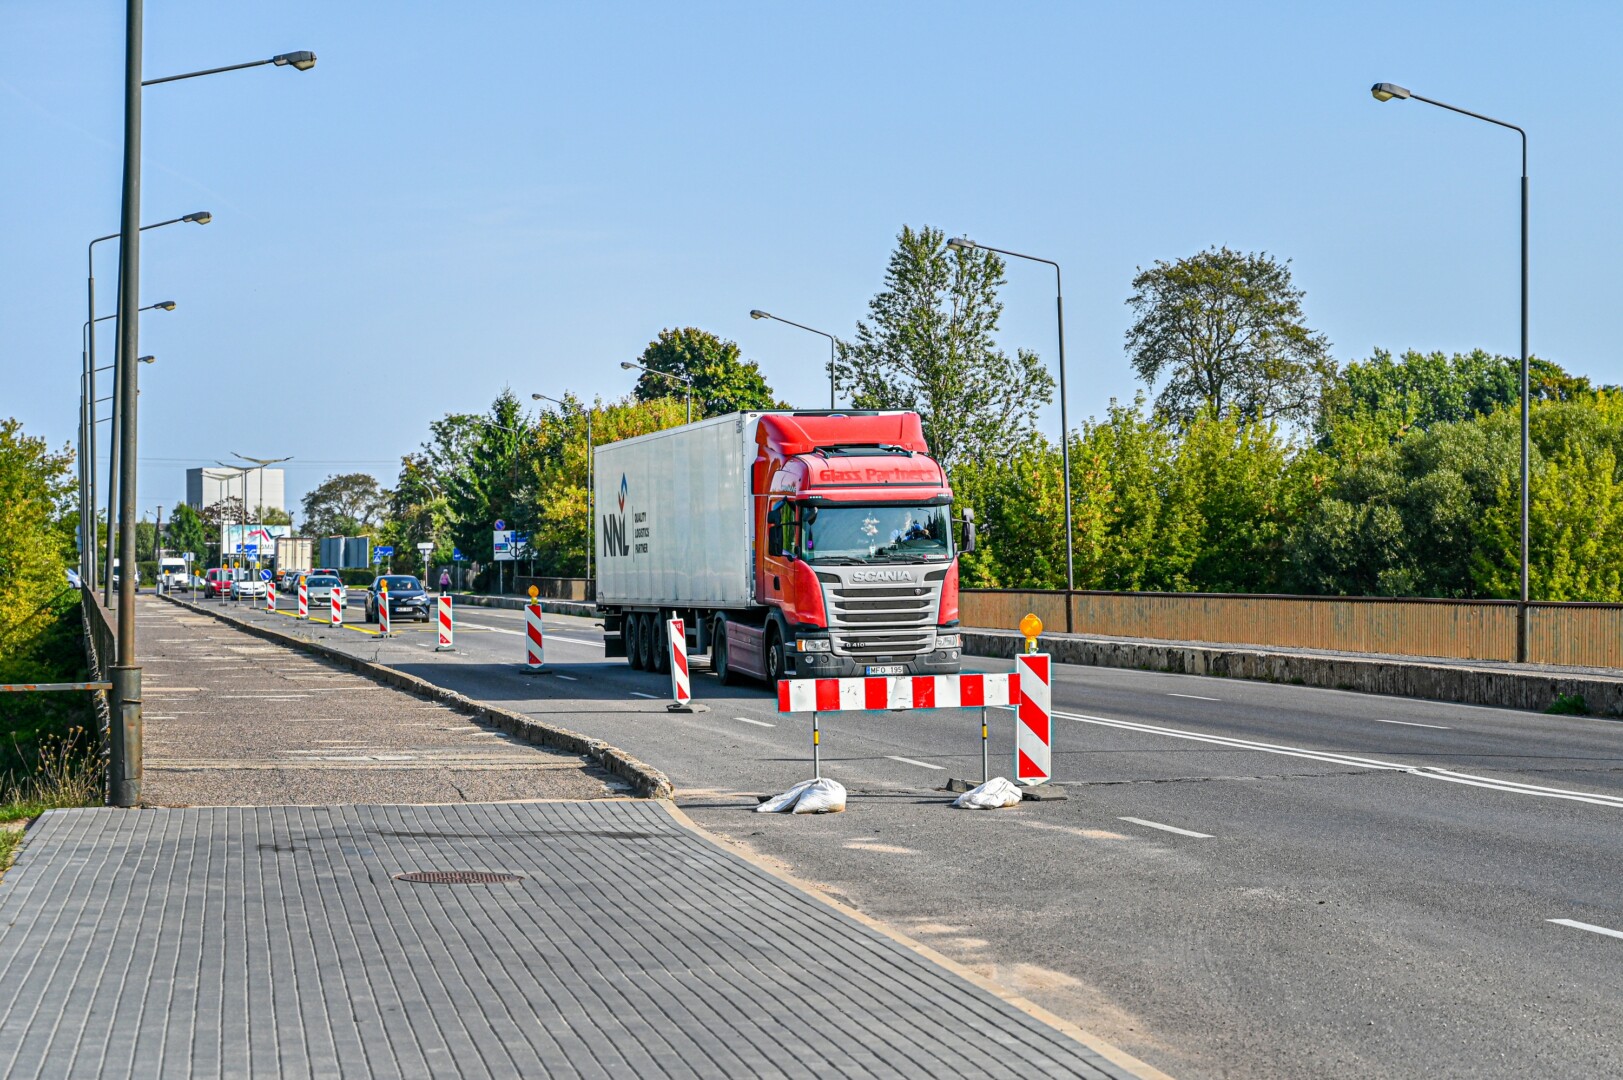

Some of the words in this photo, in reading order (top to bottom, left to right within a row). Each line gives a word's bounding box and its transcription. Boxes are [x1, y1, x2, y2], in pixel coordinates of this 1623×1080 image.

[819, 468, 862, 482] Glass
[865, 468, 936, 482] Partners
[635, 512, 646, 523] QUALITY
[603, 513, 630, 557] NNL
[635, 528, 649, 538] LOGISTICS
[635, 543, 648, 554] PARTNER
[852, 570, 913, 584] SCANIA
[870, 666, 886, 674] MFO
[890, 666, 903, 674] 195
